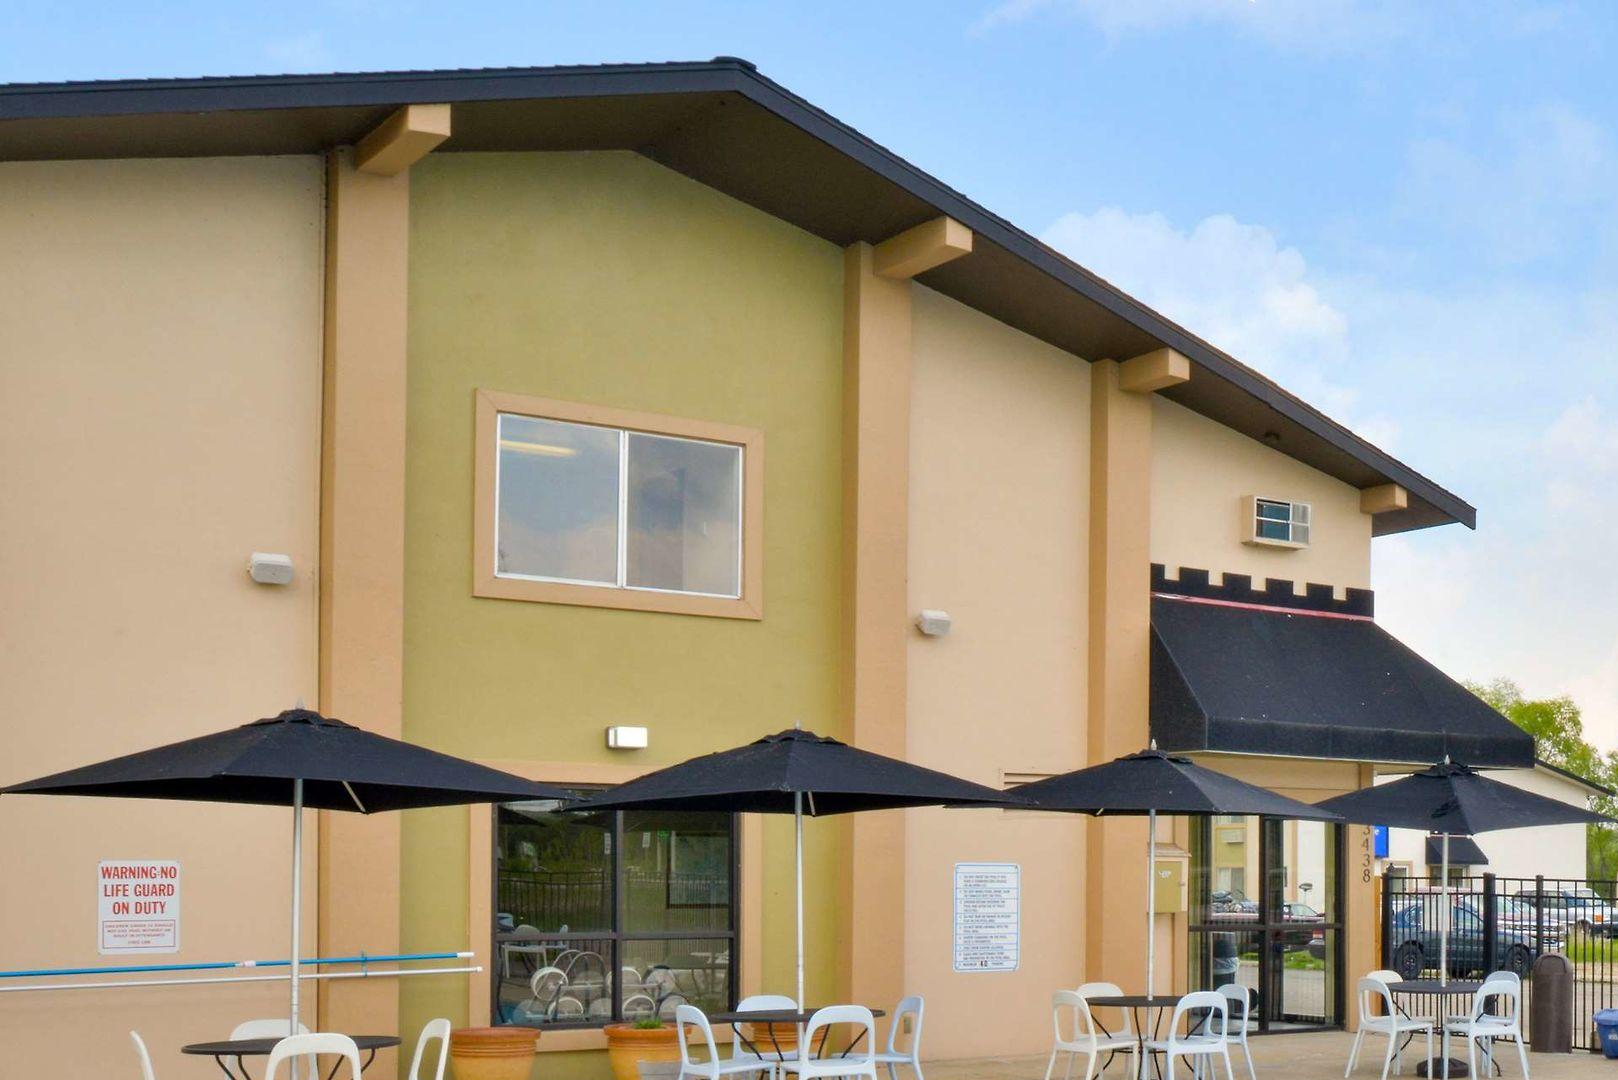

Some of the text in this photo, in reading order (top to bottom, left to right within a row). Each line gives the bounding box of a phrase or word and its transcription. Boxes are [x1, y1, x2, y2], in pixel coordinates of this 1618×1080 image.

[104, 884, 175, 897] LIFE GUARD
[113, 902, 166, 914] ON DUTY
